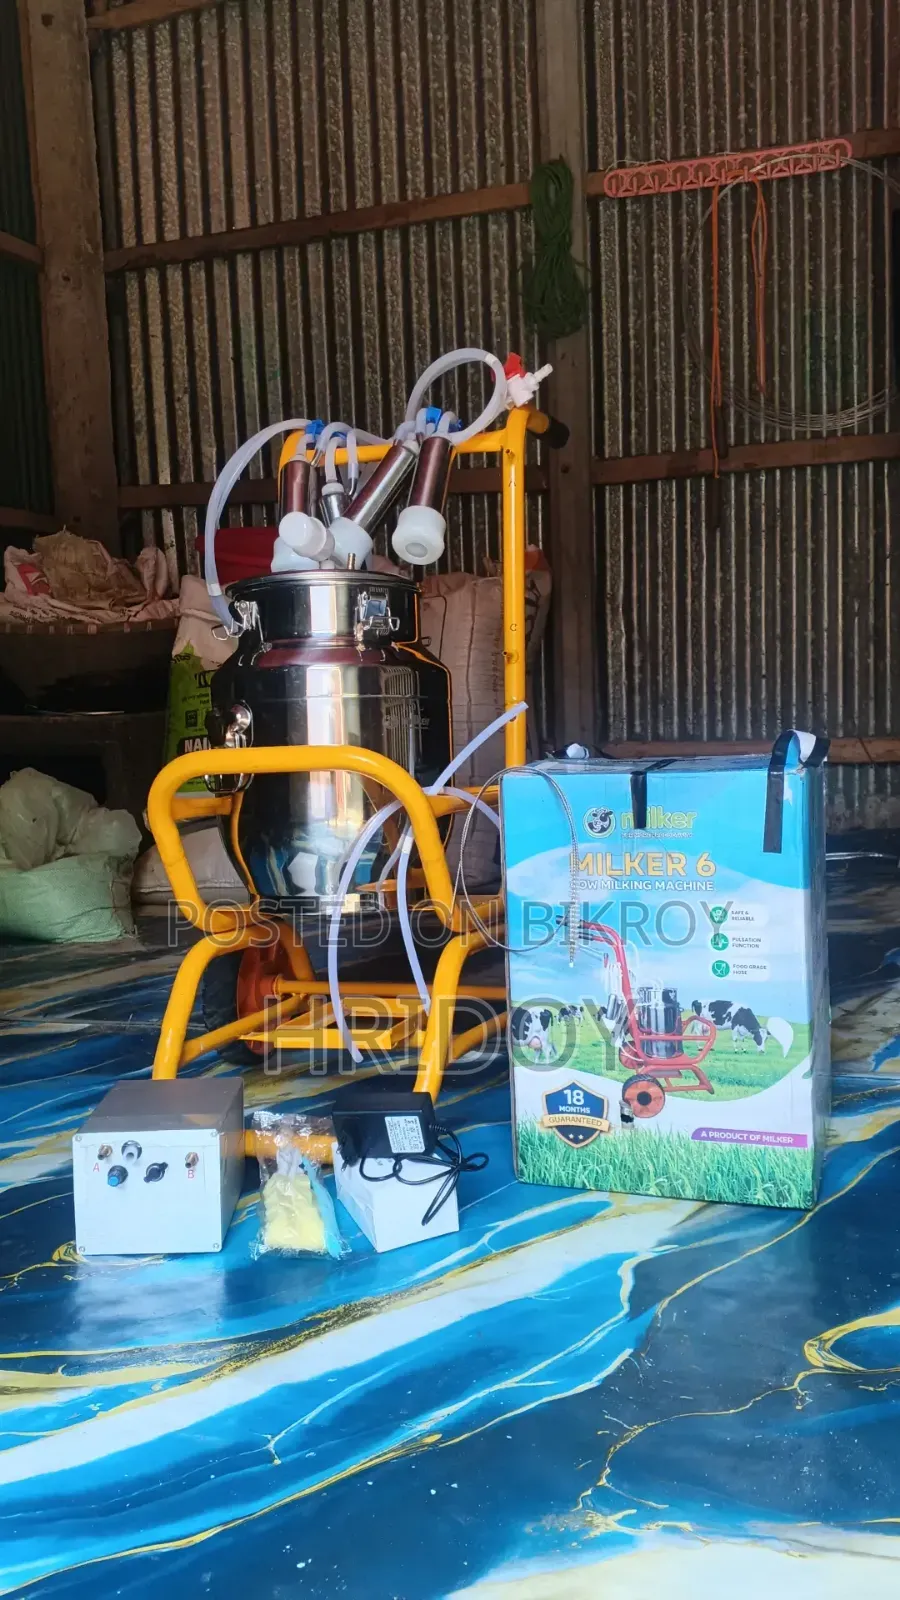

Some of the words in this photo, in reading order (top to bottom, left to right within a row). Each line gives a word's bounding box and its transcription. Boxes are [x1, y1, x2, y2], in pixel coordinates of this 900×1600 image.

[569, 851, 687, 877] MILKER
[696, 851, 717, 877] 6
[601, 879, 653, 890] MILKING
[655, 880, 715, 891] MACHINE
[563, 1089, 585, 1106] 18
[558, 1105, 591, 1114] MONTHS
[548, 1115, 603, 1127] GUARANTEED
[700, 1130, 708, 1138] A
[708, 1131, 748, 1141] PRODUCT
[749, 1134, 761, 1142] OF
[762, 1135, 794, 1144] MILKER
[92, 1162, 100, 1173] A
[187, 1168, 195, 1179] B
